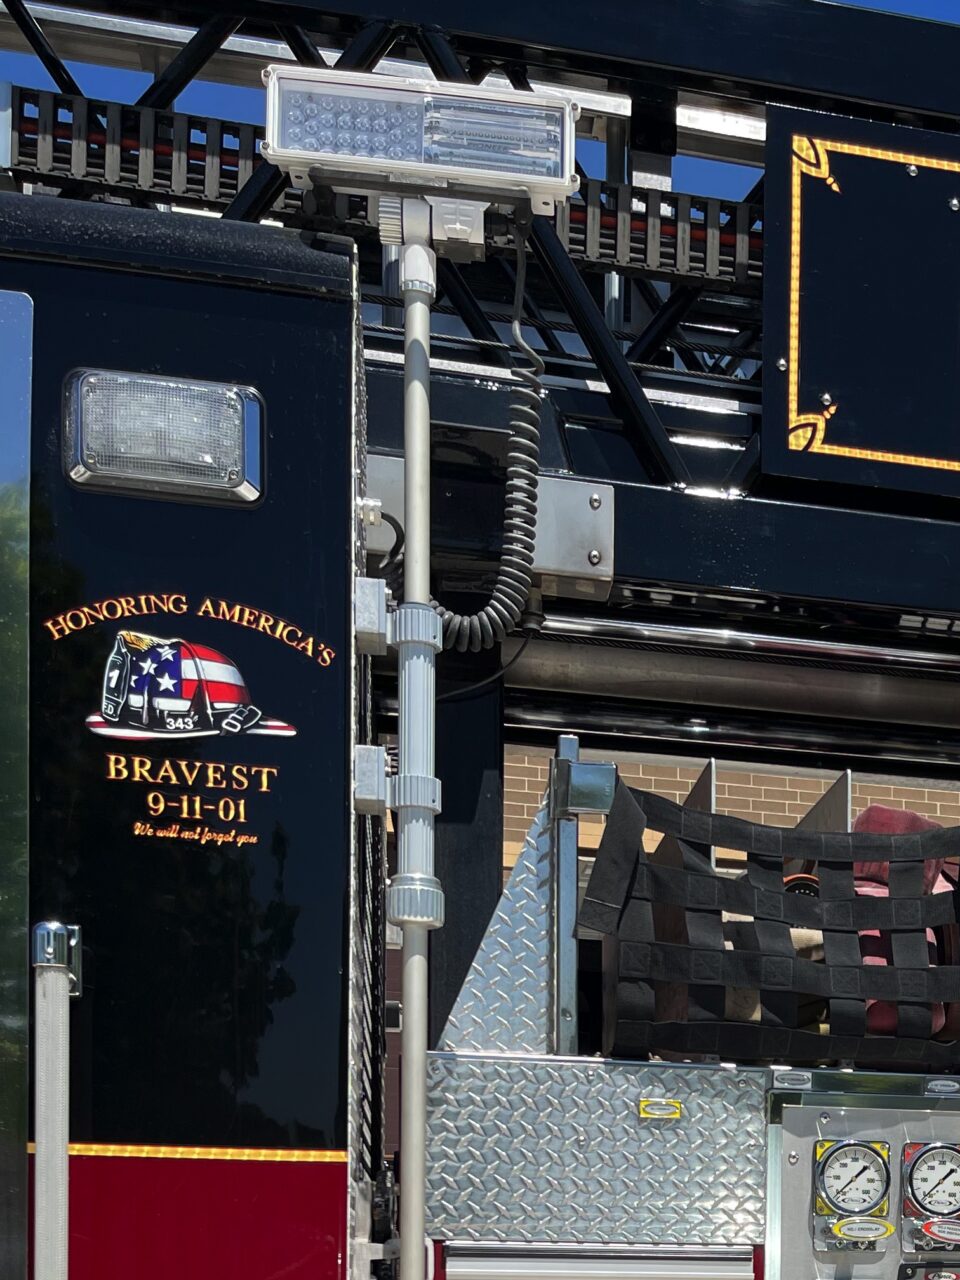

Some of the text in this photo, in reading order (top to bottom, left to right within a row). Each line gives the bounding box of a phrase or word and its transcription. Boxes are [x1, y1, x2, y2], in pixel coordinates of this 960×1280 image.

[43, 594, 336, 667] HONORING AMERICA'S
[166, 717, 194, 730] 343
[105, 753, 278, 792] BRAVEST
[147, 792, 248, 823] 9-11-01
[133, 822, 258, 847] We will not forget you
[932, 1273, 953, 1280] Pierce
